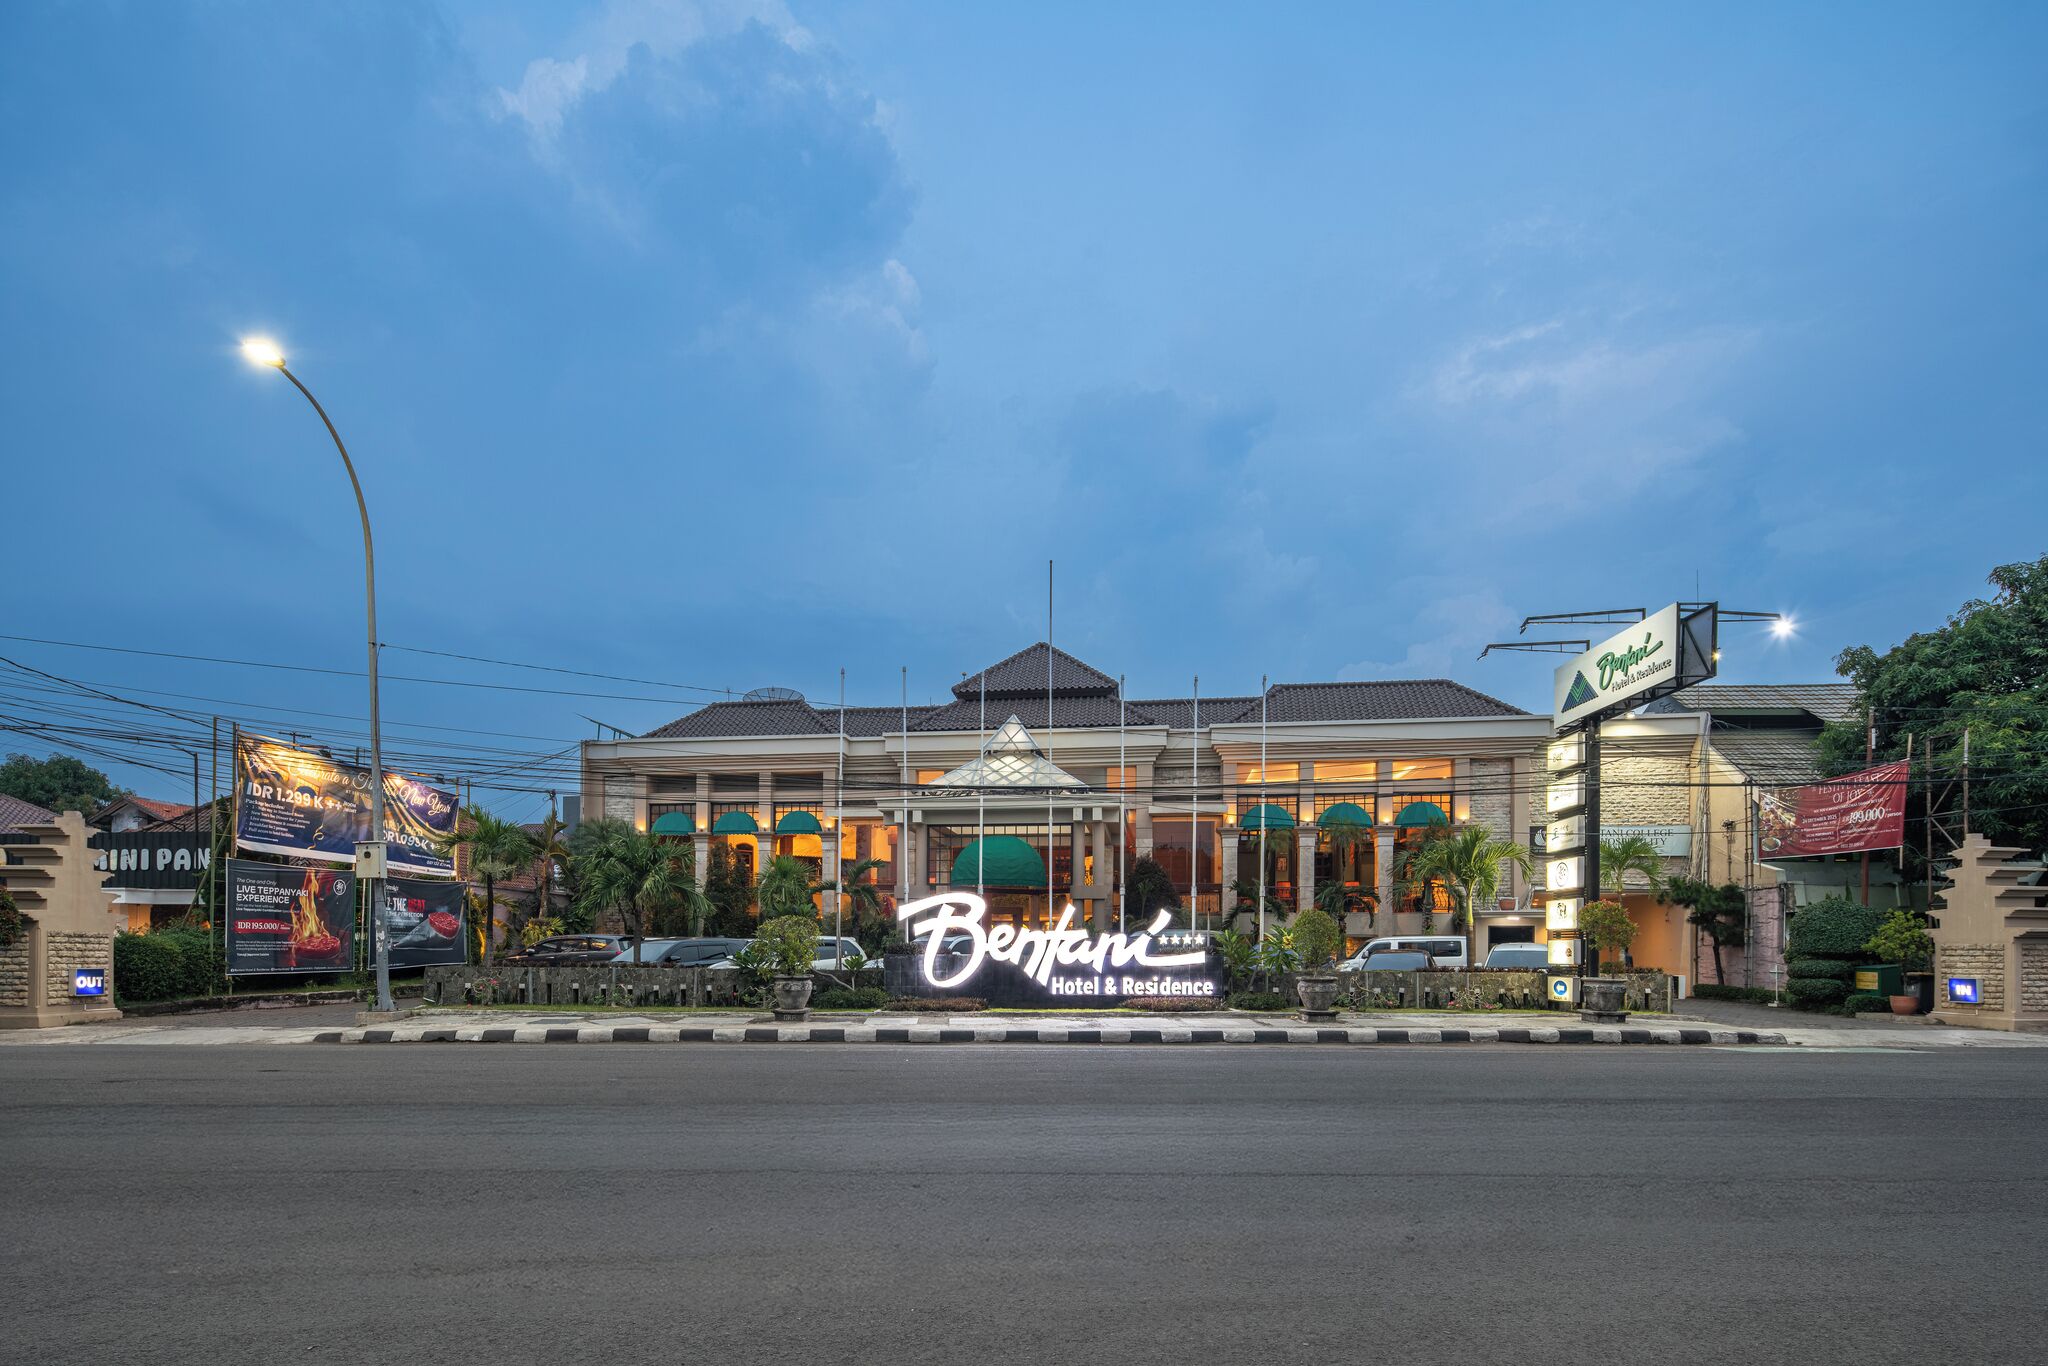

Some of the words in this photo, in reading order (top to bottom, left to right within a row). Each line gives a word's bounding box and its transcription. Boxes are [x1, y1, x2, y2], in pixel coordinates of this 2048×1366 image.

[1596, 632, 1663, 690] Bentani
[1612, 674, 1630, 692] Hotel
[1630, 673, 1637, 684] &
[1637, 659, 1672, 680] Residence
[246, 782, 274, 800] IDR
[276, 788, 311, 806] 1.299
[314, 796, 324, 809] K
[236, 885, 256, 894] LIVE
[257, 886, 308, 897] TEPPANYAKI
[236, 894, 290, 904] EXPERIENCE
[899, 892, 1205, 987] Bentani
[76, 976, 103, 988] OUT
[1052, 976, 1099, 996] Hotel
[1104, 976, 1118, 996] &
[1122, 976, 1214, 996] Residence
[1956, 985, 1972, 996] IN
